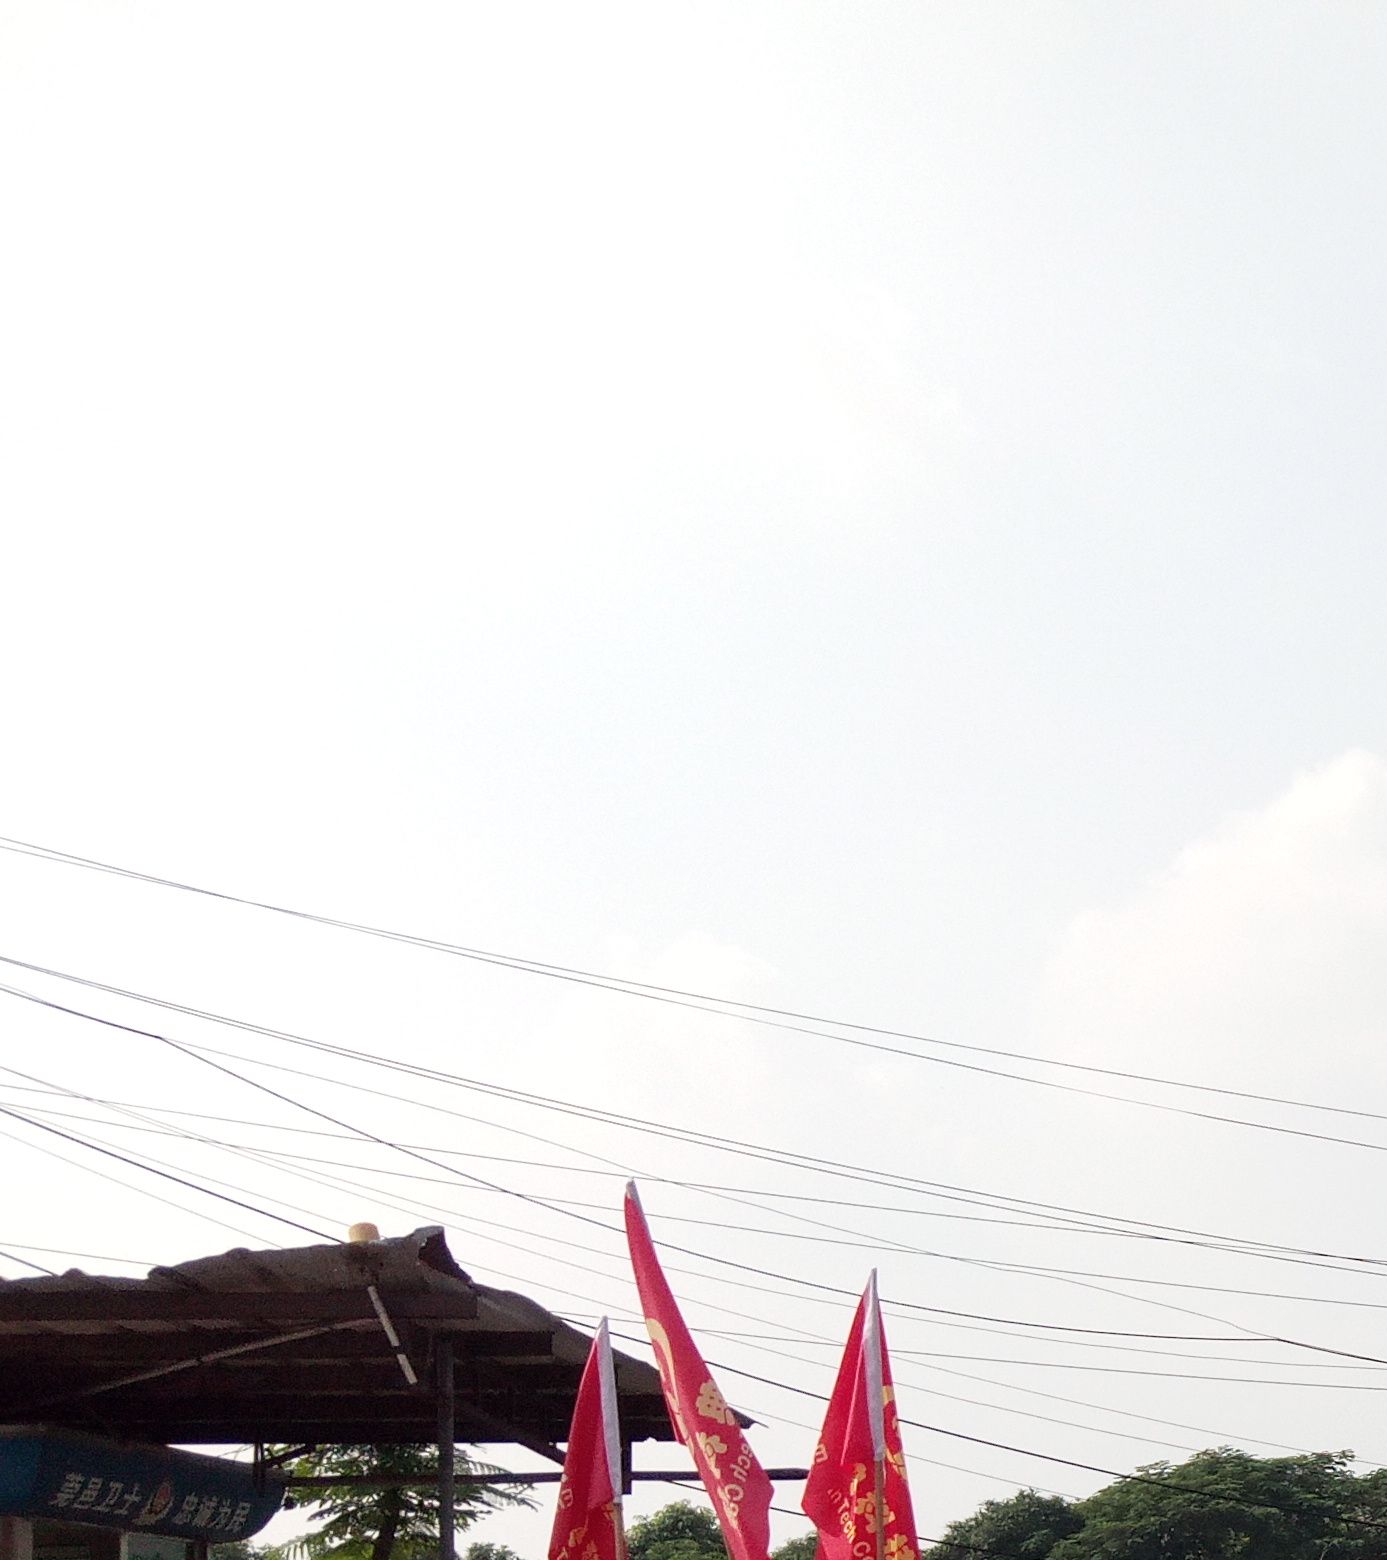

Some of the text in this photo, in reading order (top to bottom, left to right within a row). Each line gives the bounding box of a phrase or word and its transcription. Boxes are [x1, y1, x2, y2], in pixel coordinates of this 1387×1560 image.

[172, 1492, 251, 1533] 忠诚为民
[837, 1499, 858, 1545] Tech
